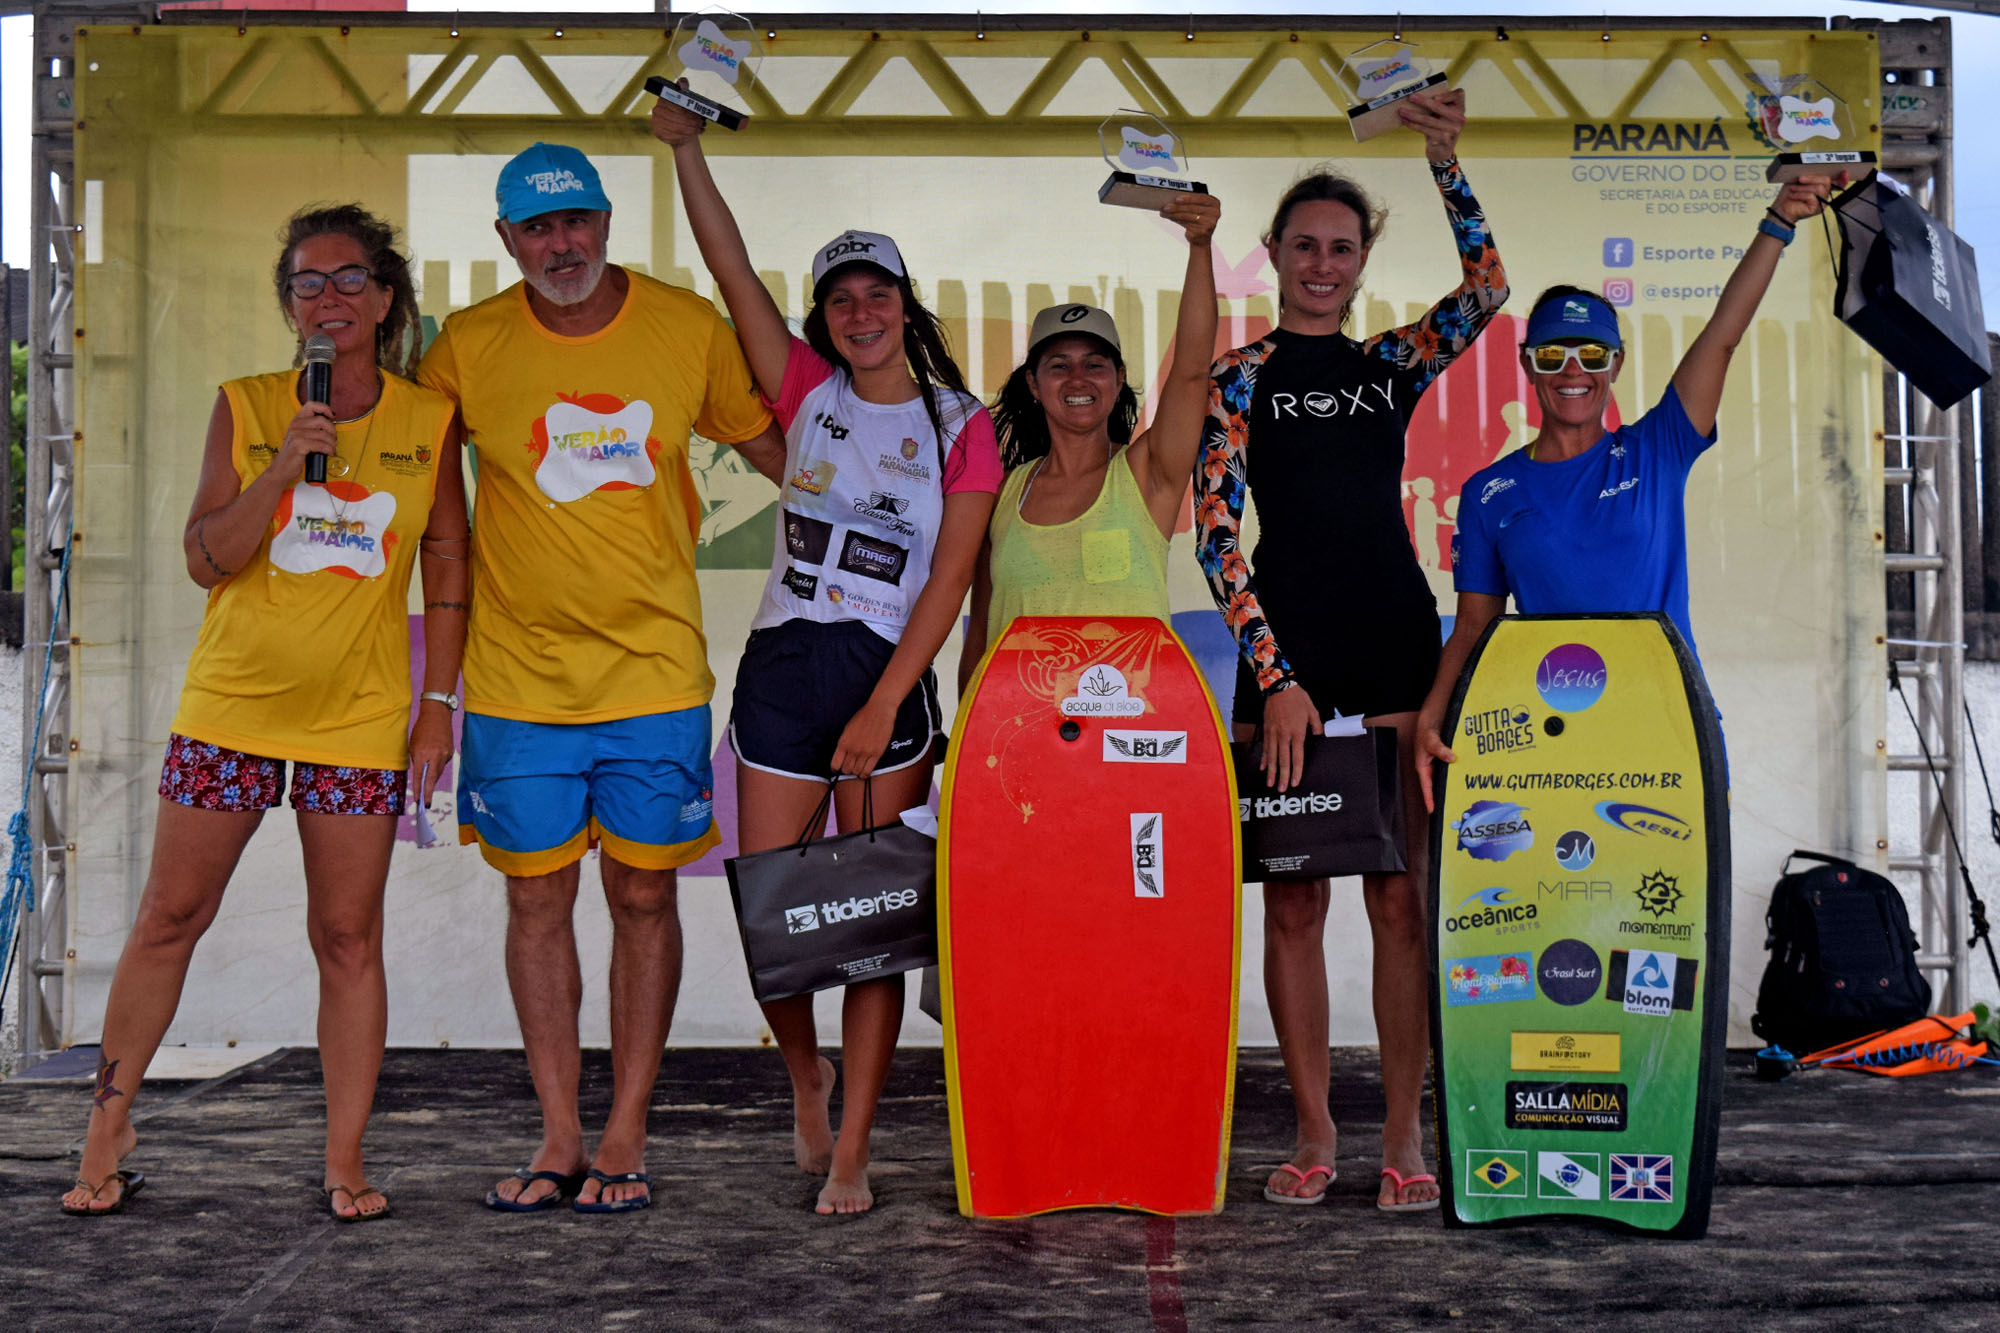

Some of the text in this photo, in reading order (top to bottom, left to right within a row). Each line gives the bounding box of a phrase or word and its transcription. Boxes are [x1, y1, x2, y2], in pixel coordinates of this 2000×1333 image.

[694, 102, 716, 118] lugar
[1573, 116, 1730, 151] PARANÁ
[1835, 153, 1856, 162] lugar
[525, 168, 574, 185] VERÃO
[1572, 165, 1686, 182] GOVERNO
[1693, 165, 1727, 182] DO
[536, 180, 584, 194] MAIOR
[1167, 178, 1188, 189] lugar
[1600, 189, 1684, 200] SECRETARIA
[1690, 189, 1709, 200] DA
[1645, 203, 1746, 214] E DO ESPORTE
[1643, 247, 1715, 262] Esporte
[1642, 284, 1722, 301] @esport
[1272, 378, 1395, 419] ROXY
[552, 423, 628, 451] VERÃO
[569, 442, 640, 461] MAIOR
[309, 530, 375, 552] MAIOR
[848, 593, 881, 606] GOLDEN
[1537, 658, 1605, 693] Jesus
[1066, 701, 1102, 714] acqua
[1465, 708, 1511, 737] GUTTA
[1477, 724, 1534, 755] BORGES
[1465, 773, 1682, 791] WWW.GUTTABORGES.COM.BR
[1254, 792, 1342, 818] tiderise
[1460, 820, 1532, 839] ASSESA
[821, 888, 918, 924] tiderise
[1445, 904, 1538, 932] oceânica
[1496, 921, 1540, 936] SPORTS
[1576, 968, 1596, 978] Surf
[1625, 989, 1670, 1009] blom
[1515, 1113, 1620, 1125] COMUNICAÇÃO VISUAL
